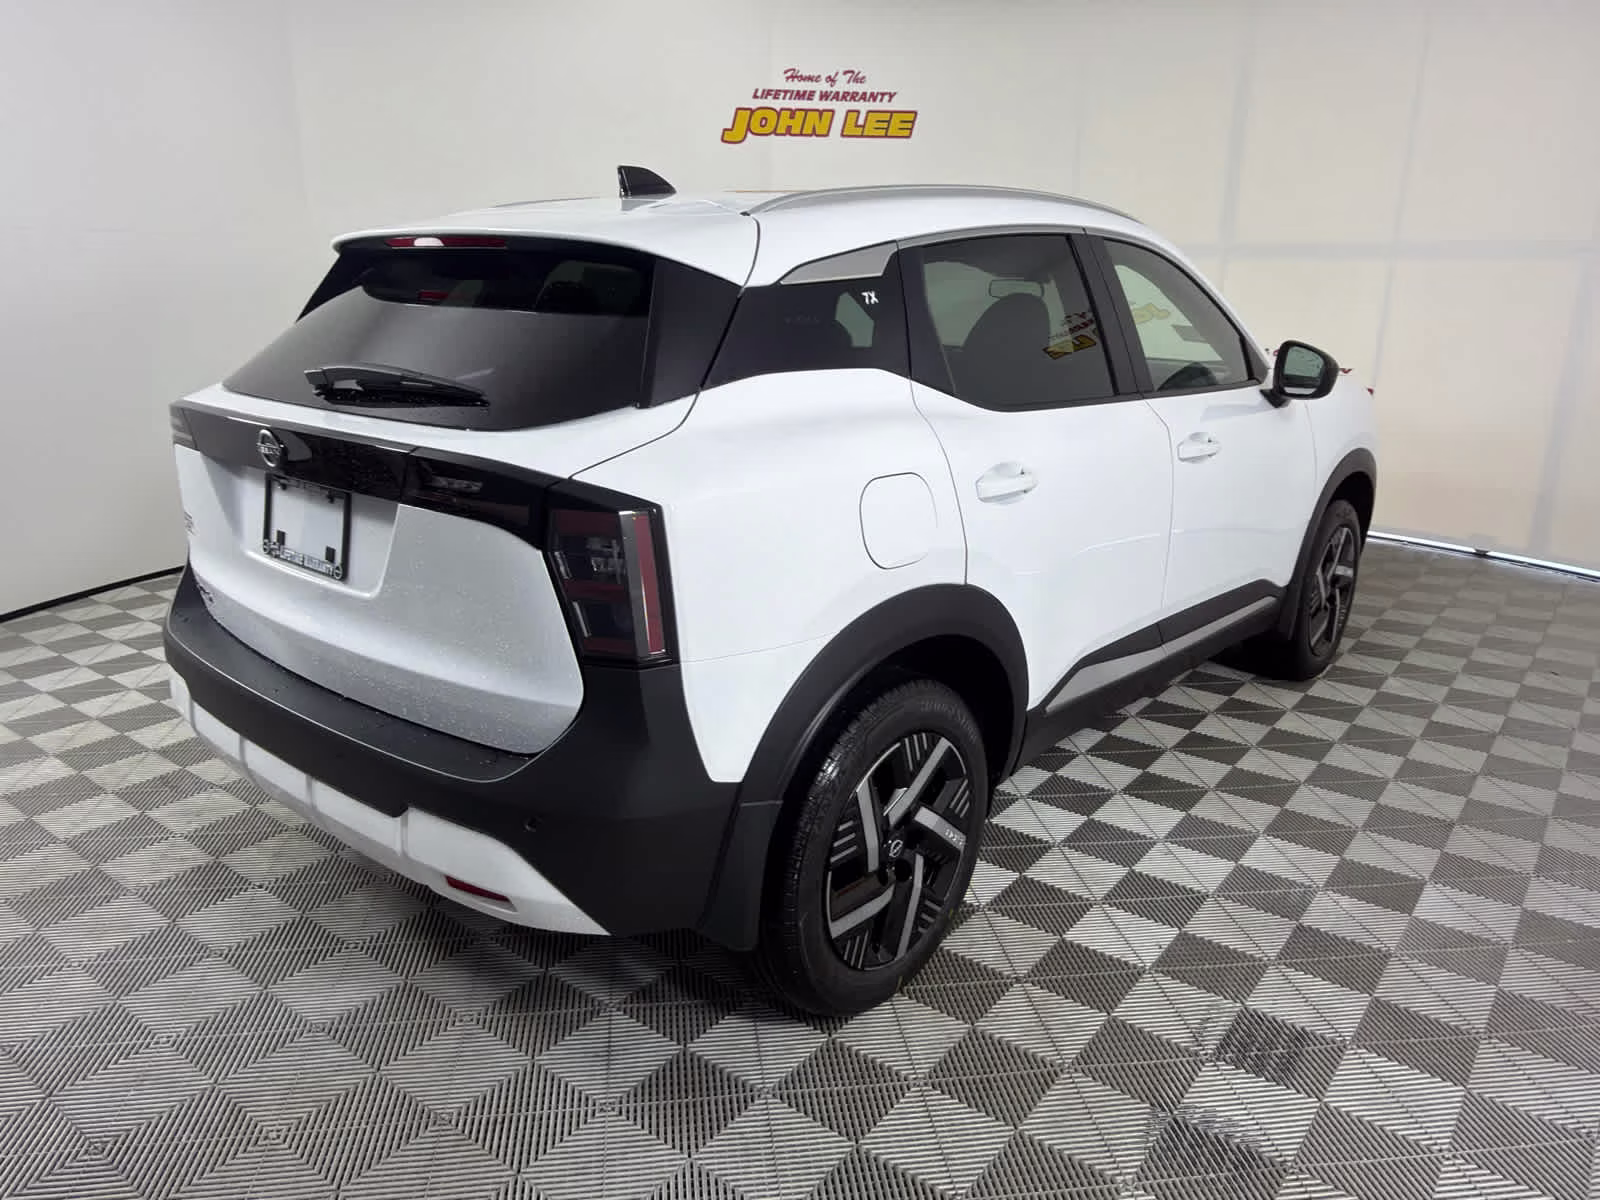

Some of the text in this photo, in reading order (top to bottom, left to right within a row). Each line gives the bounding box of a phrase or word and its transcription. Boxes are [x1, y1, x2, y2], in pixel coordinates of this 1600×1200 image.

[783, 68, 866, 86] Home of The
[752, 88, 896, 102] LIFETIME WARRANTY
[721, 107, 917, 143] JOHN LEE
